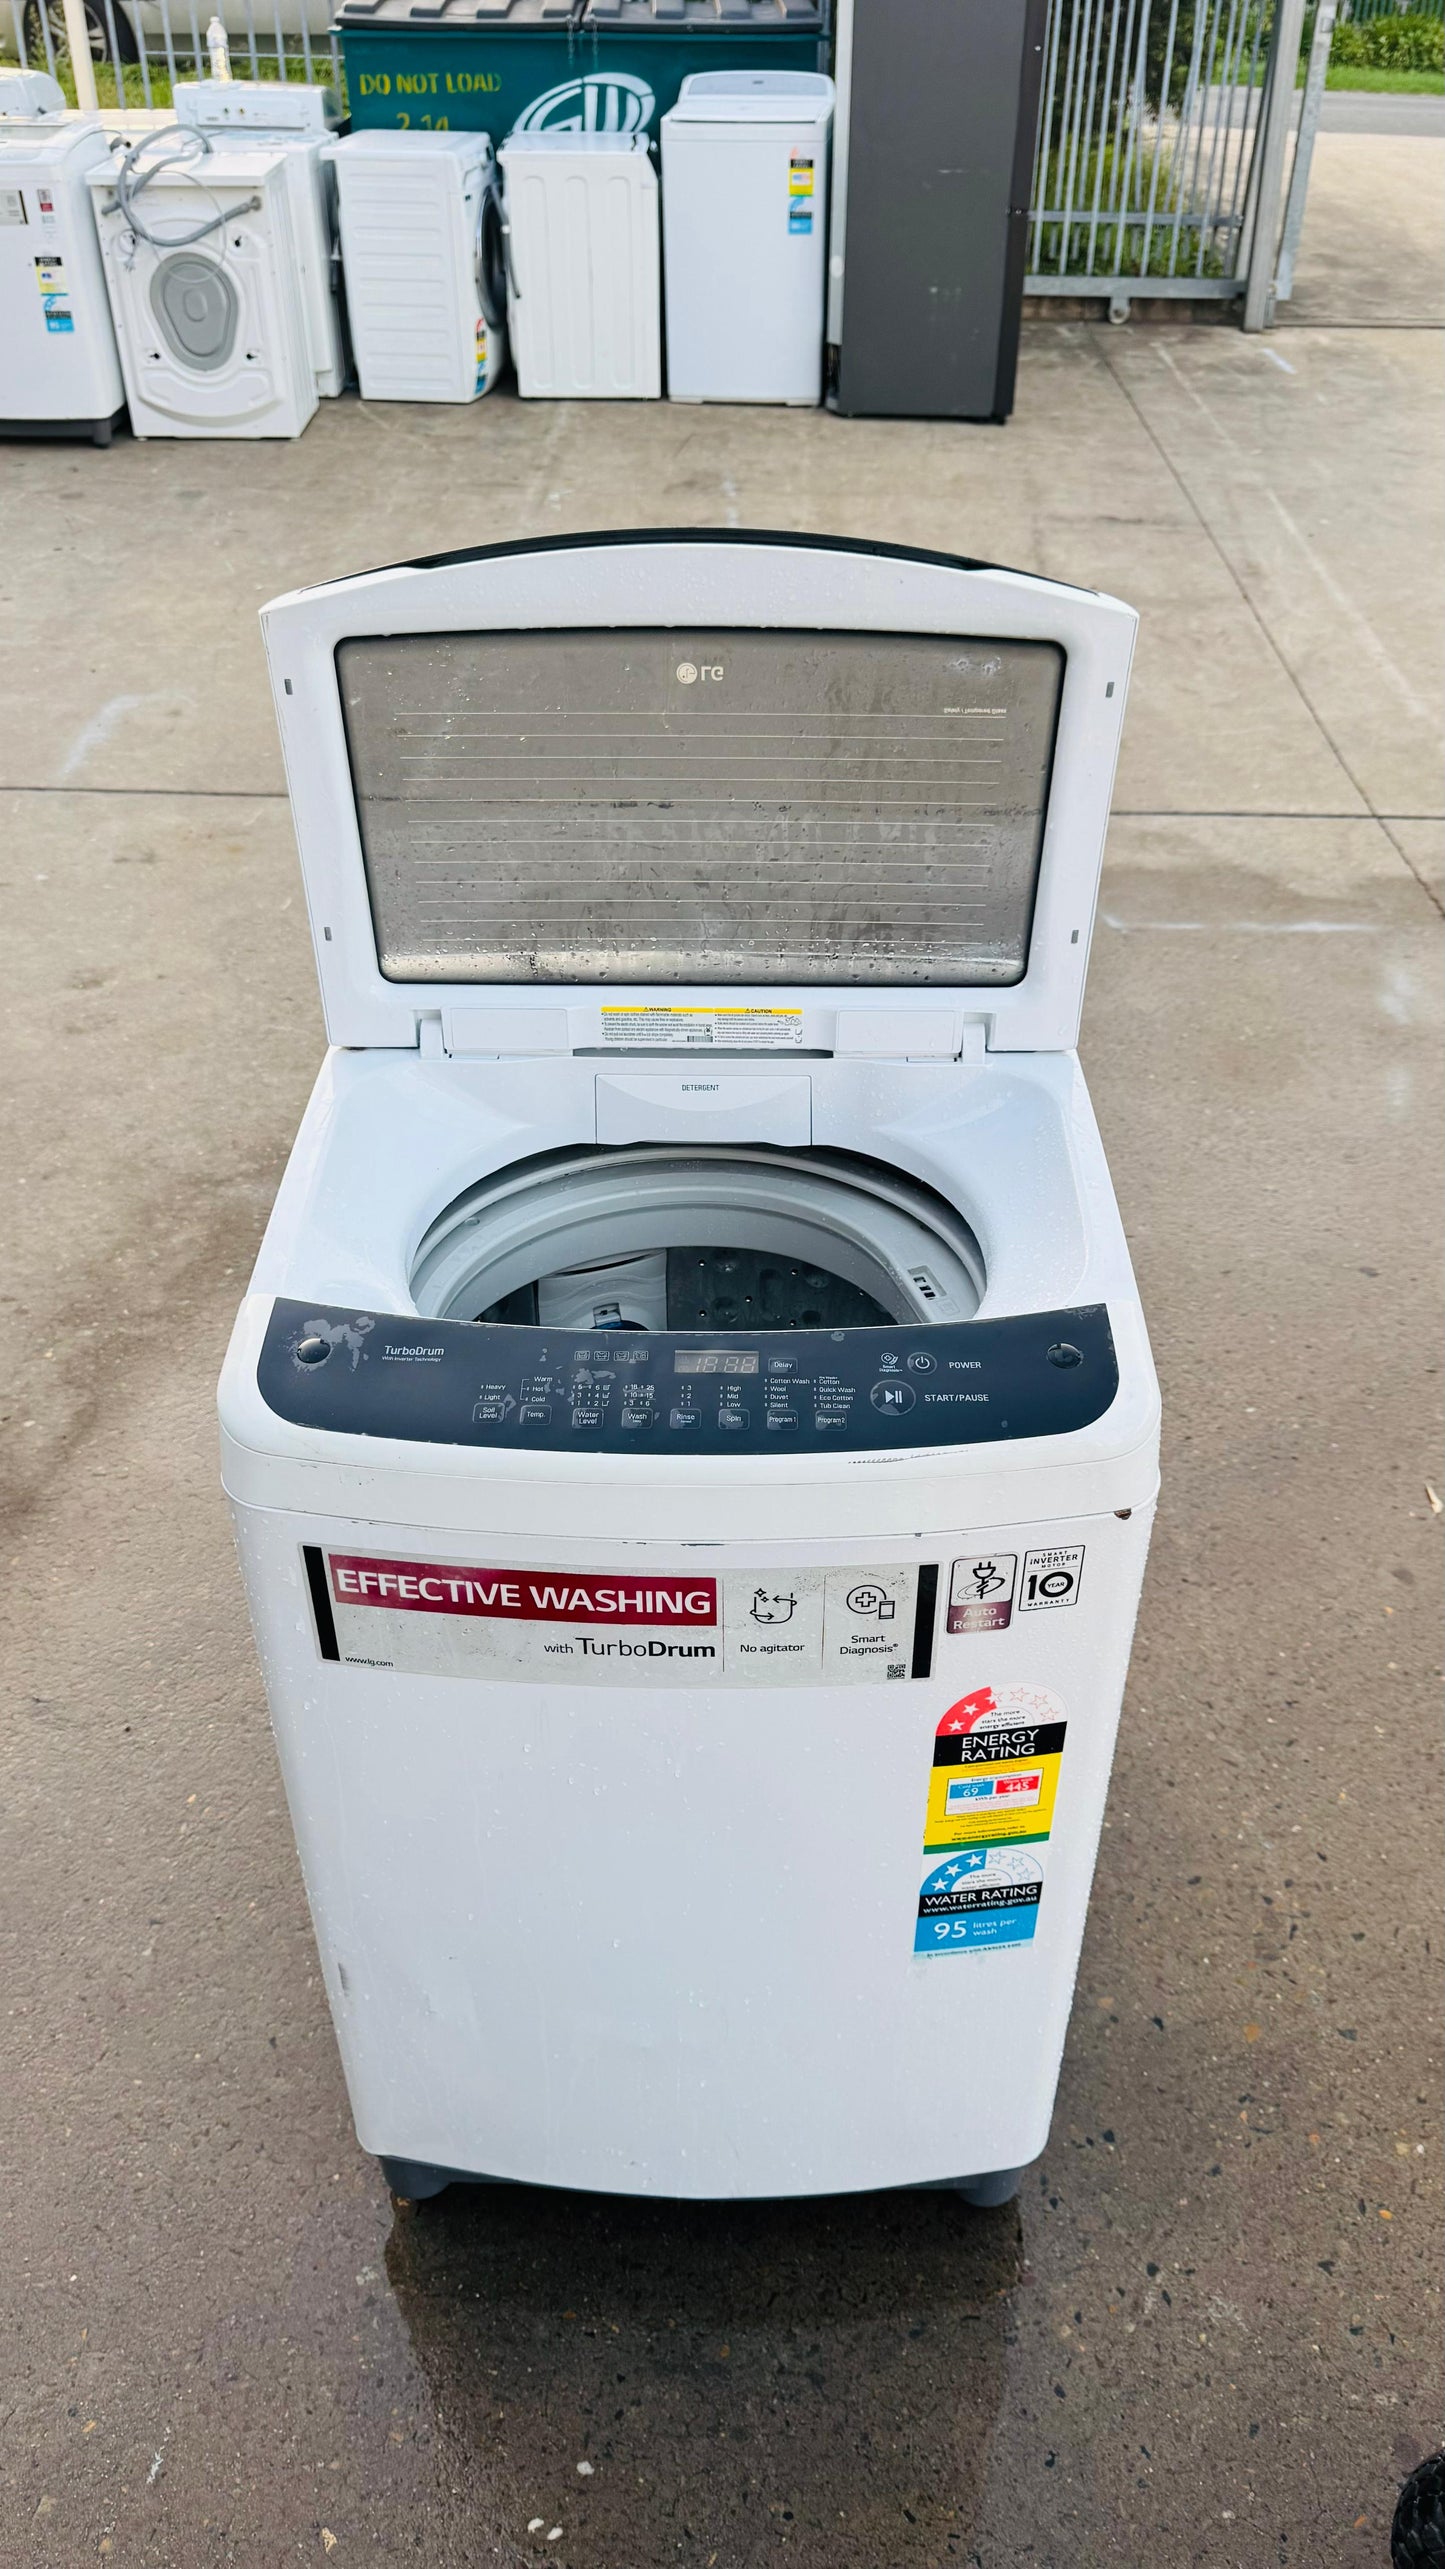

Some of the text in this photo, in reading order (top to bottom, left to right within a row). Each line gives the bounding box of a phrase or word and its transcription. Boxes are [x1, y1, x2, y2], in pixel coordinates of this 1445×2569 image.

[360, 73, 500, 95] DO NOT LOAD
[385, 1345, 445, 1355] TurboDrum
[924, 1394, 989, 1402] START/PAUSE
[1030, 1554, 1078, 1564] INVERTER
[335, 1568, 711, 1614] EFFECTIVE WASHING
[1028, 1571, 1074, 1600] 10
[963, 1606, 996, 1618] Auto
[954, 1617, 1004, 1630] Restart
[851, 1634, 885, 1644] Smart
[544, 1637, 716, 1658] with TurboDrum
[740, 1642, 805, 1654] No agitator
[345, 1656, 393, 1667] www.lg.com
[962, 1729, 1040, 1749] ENERGY
[962, 1743, 1036, 1762] RATING
[963, 1788, 978, 1796] 69
[1006, 1781, 1029, 1792] 445
[925, 1885, 1038, 1906] WATER RATING
[923, 1896, 1037, 1914] www.waterrating.gov.au
[973, 1918, 1017, 1929] litres per
[934, 1920, 967, 1940] 95
[973, 1928, 997, 1937] wash
